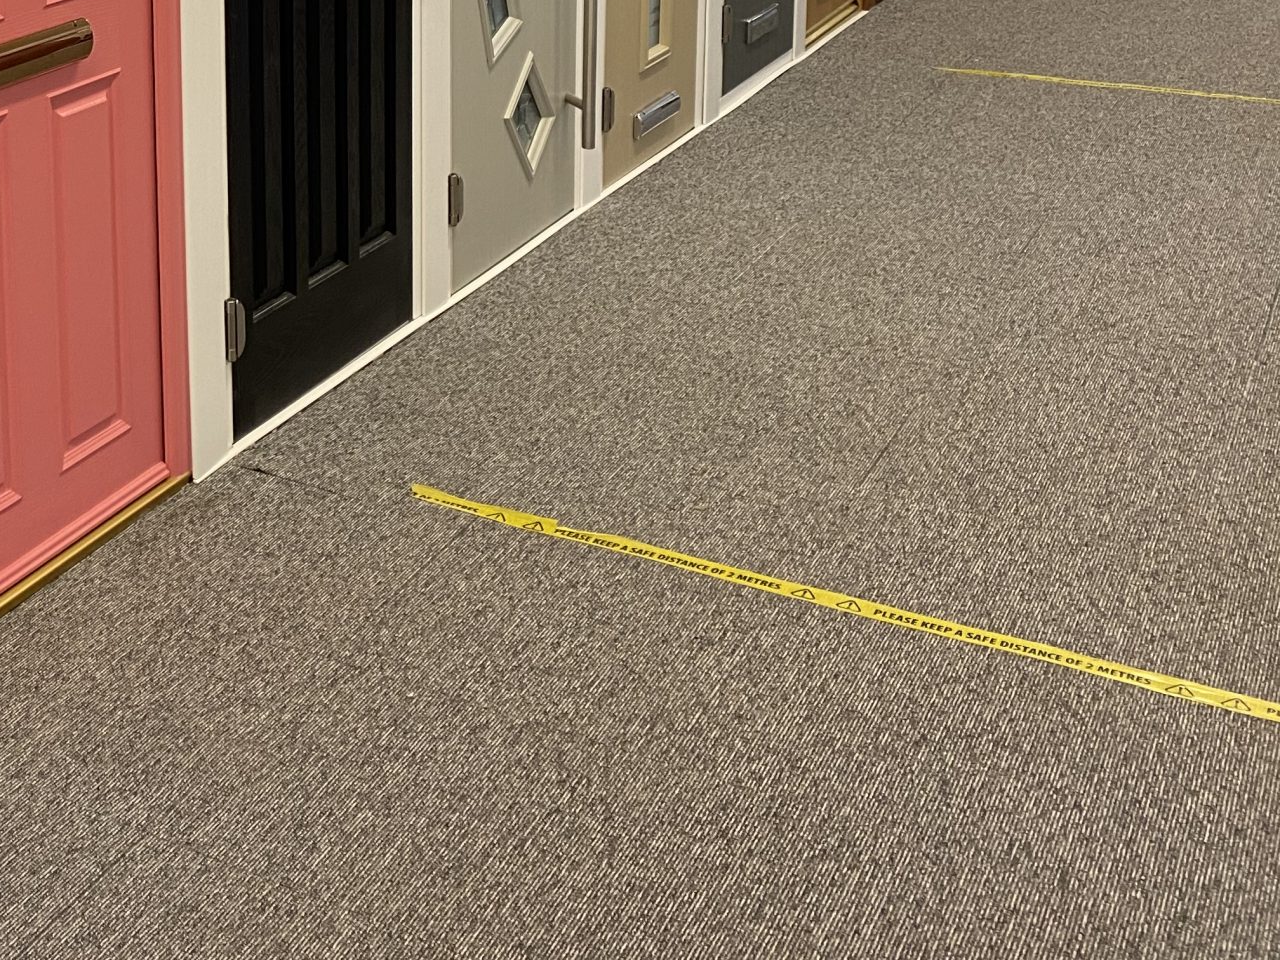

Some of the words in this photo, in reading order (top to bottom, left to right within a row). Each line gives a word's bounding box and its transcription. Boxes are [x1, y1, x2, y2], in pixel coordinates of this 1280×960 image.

[554, 528, 591, 542] PLEASE
[592, 538, 620, 548] KEEP
[629, 547, 657, 558] SAFE
[657, 554, 710, 572] DISTANCE
[710, 567, 726, 575] OF
[736, 574, 782, 590] METRES
[873, 609, 919, 626] PLEASE
[920, 621, 953, 633] KEEP
[966, 632, 998, 644] SAFE
[999, 640, 1063, 662] DISTANCE
[1065, 657, 1083, 666] OF
[1097, 665, 1153, 685] METRES
